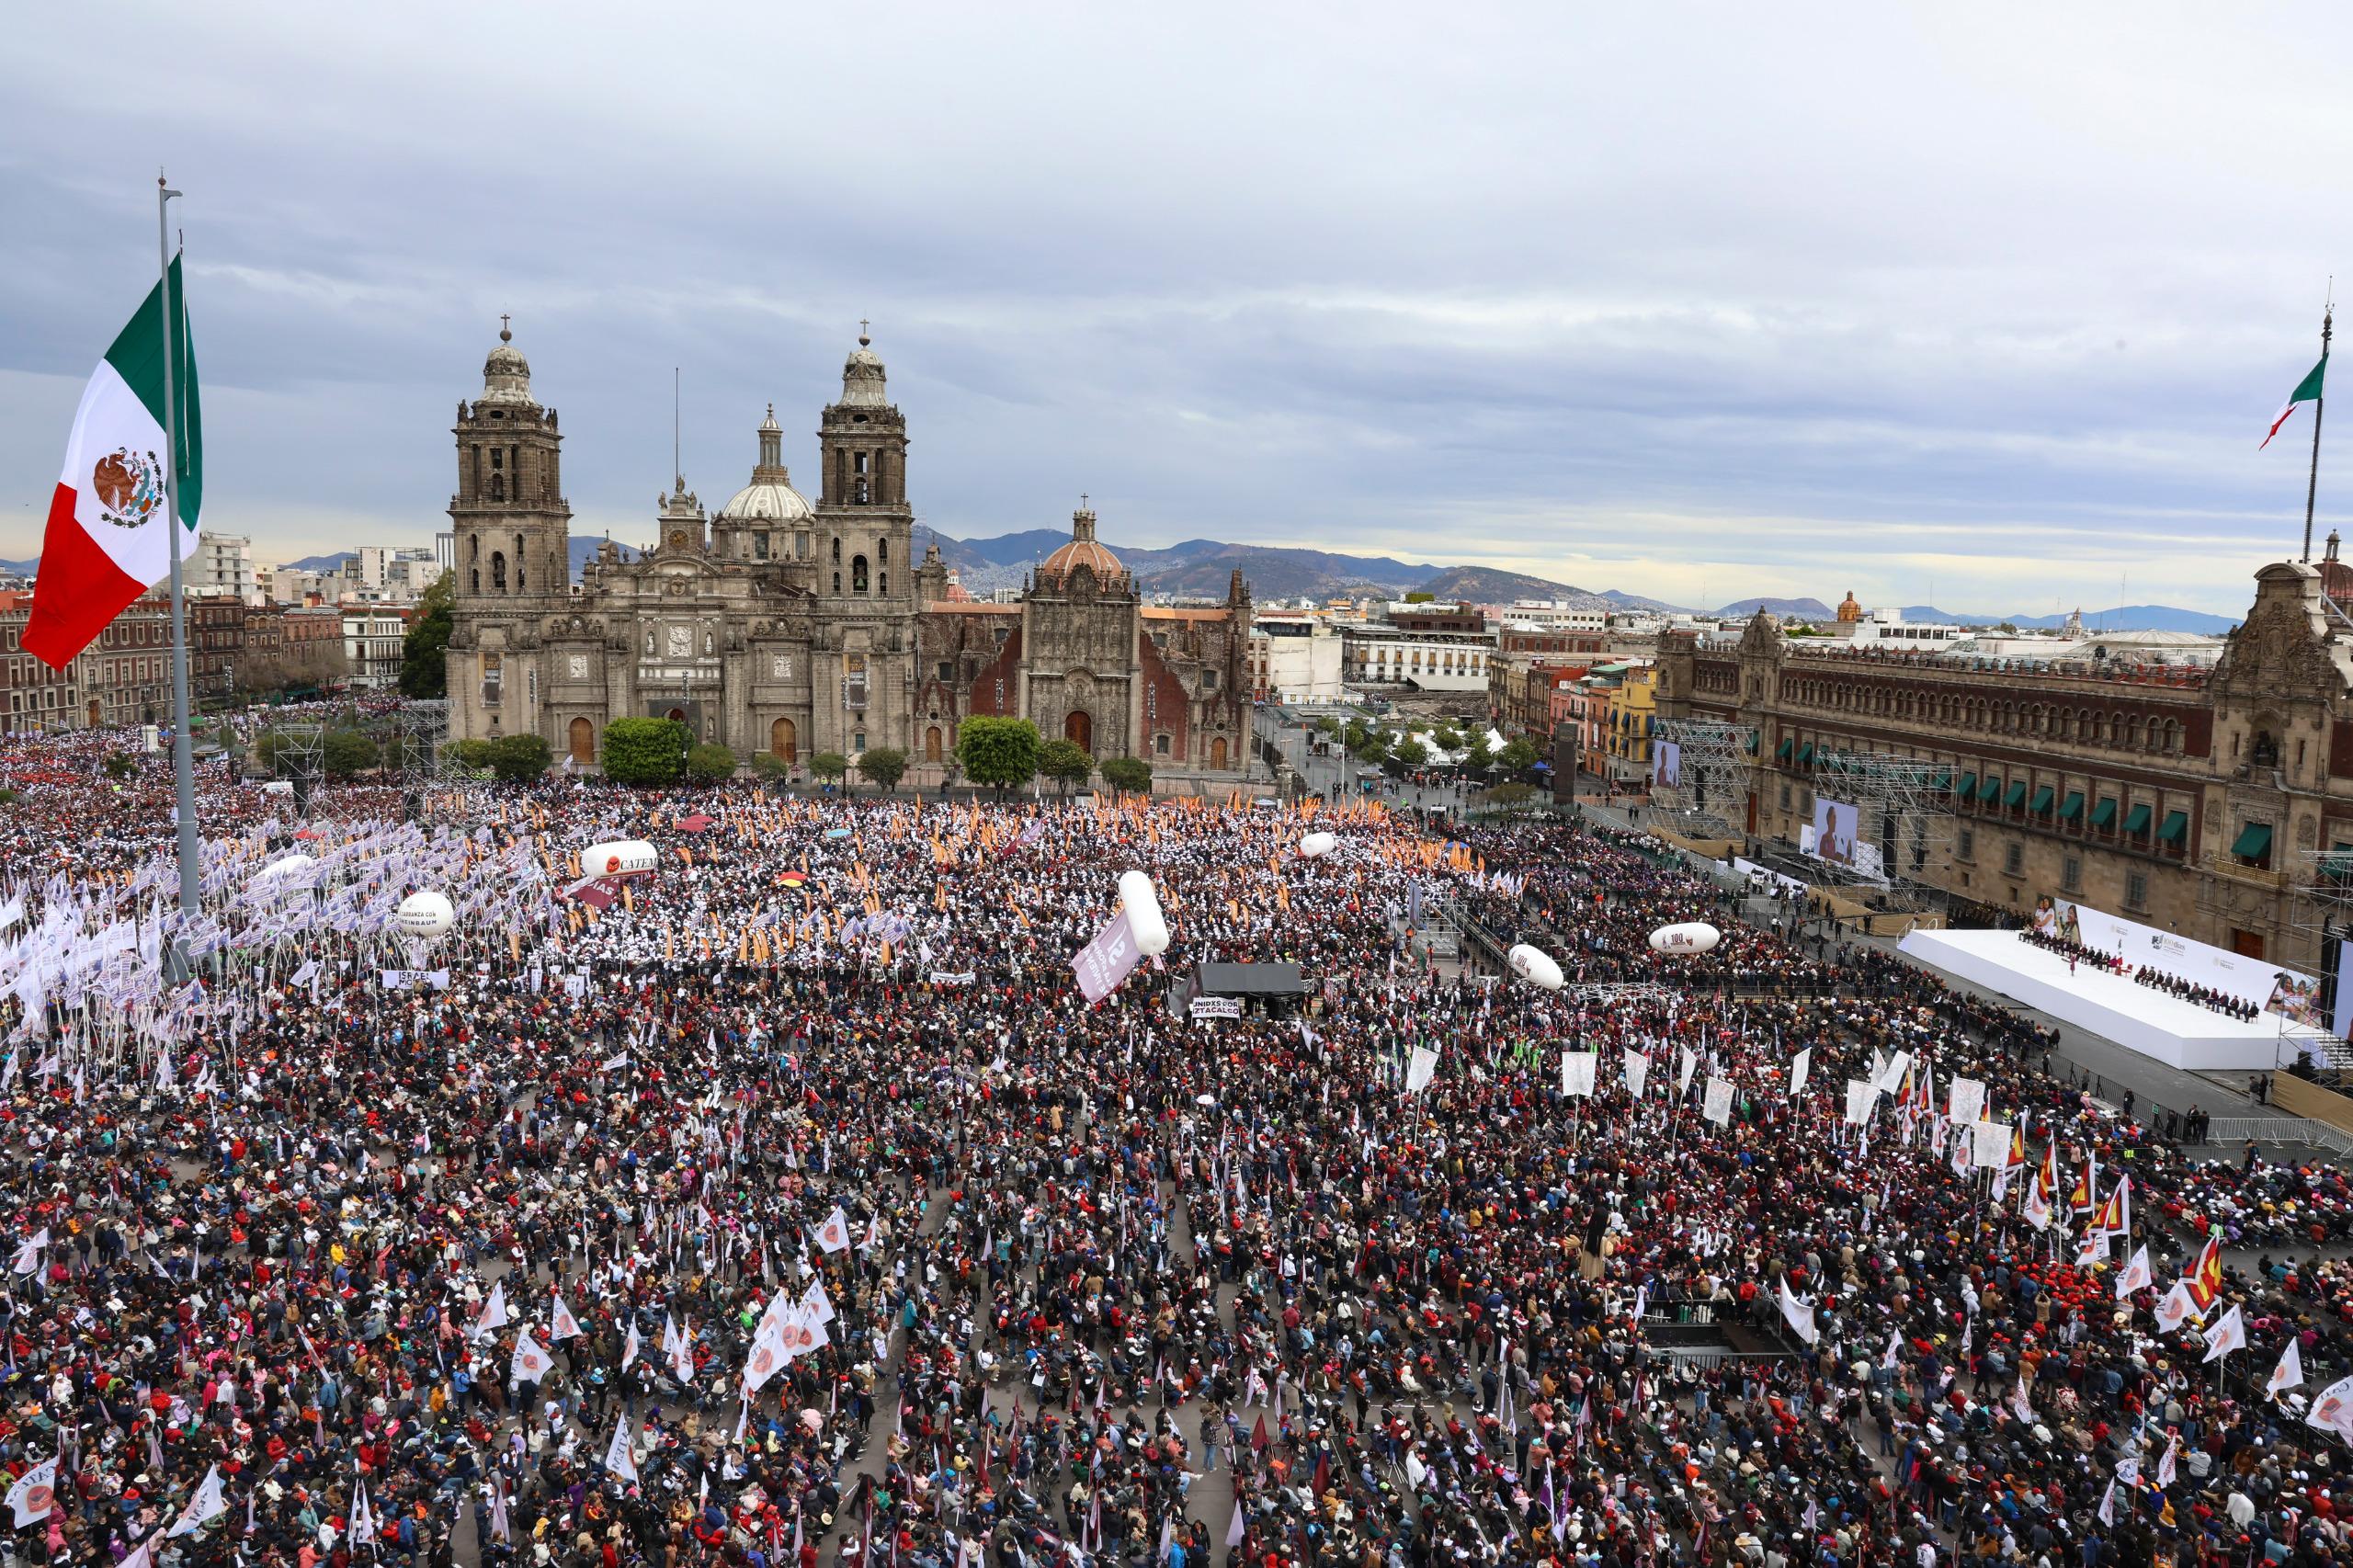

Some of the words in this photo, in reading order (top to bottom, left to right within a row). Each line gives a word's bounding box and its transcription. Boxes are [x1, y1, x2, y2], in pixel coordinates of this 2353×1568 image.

[620, 857, 656, 870] CATEM
[1671, 933, 1684, 943] 100
[1192, 1006, 1239, 1015] IZTACALCO
